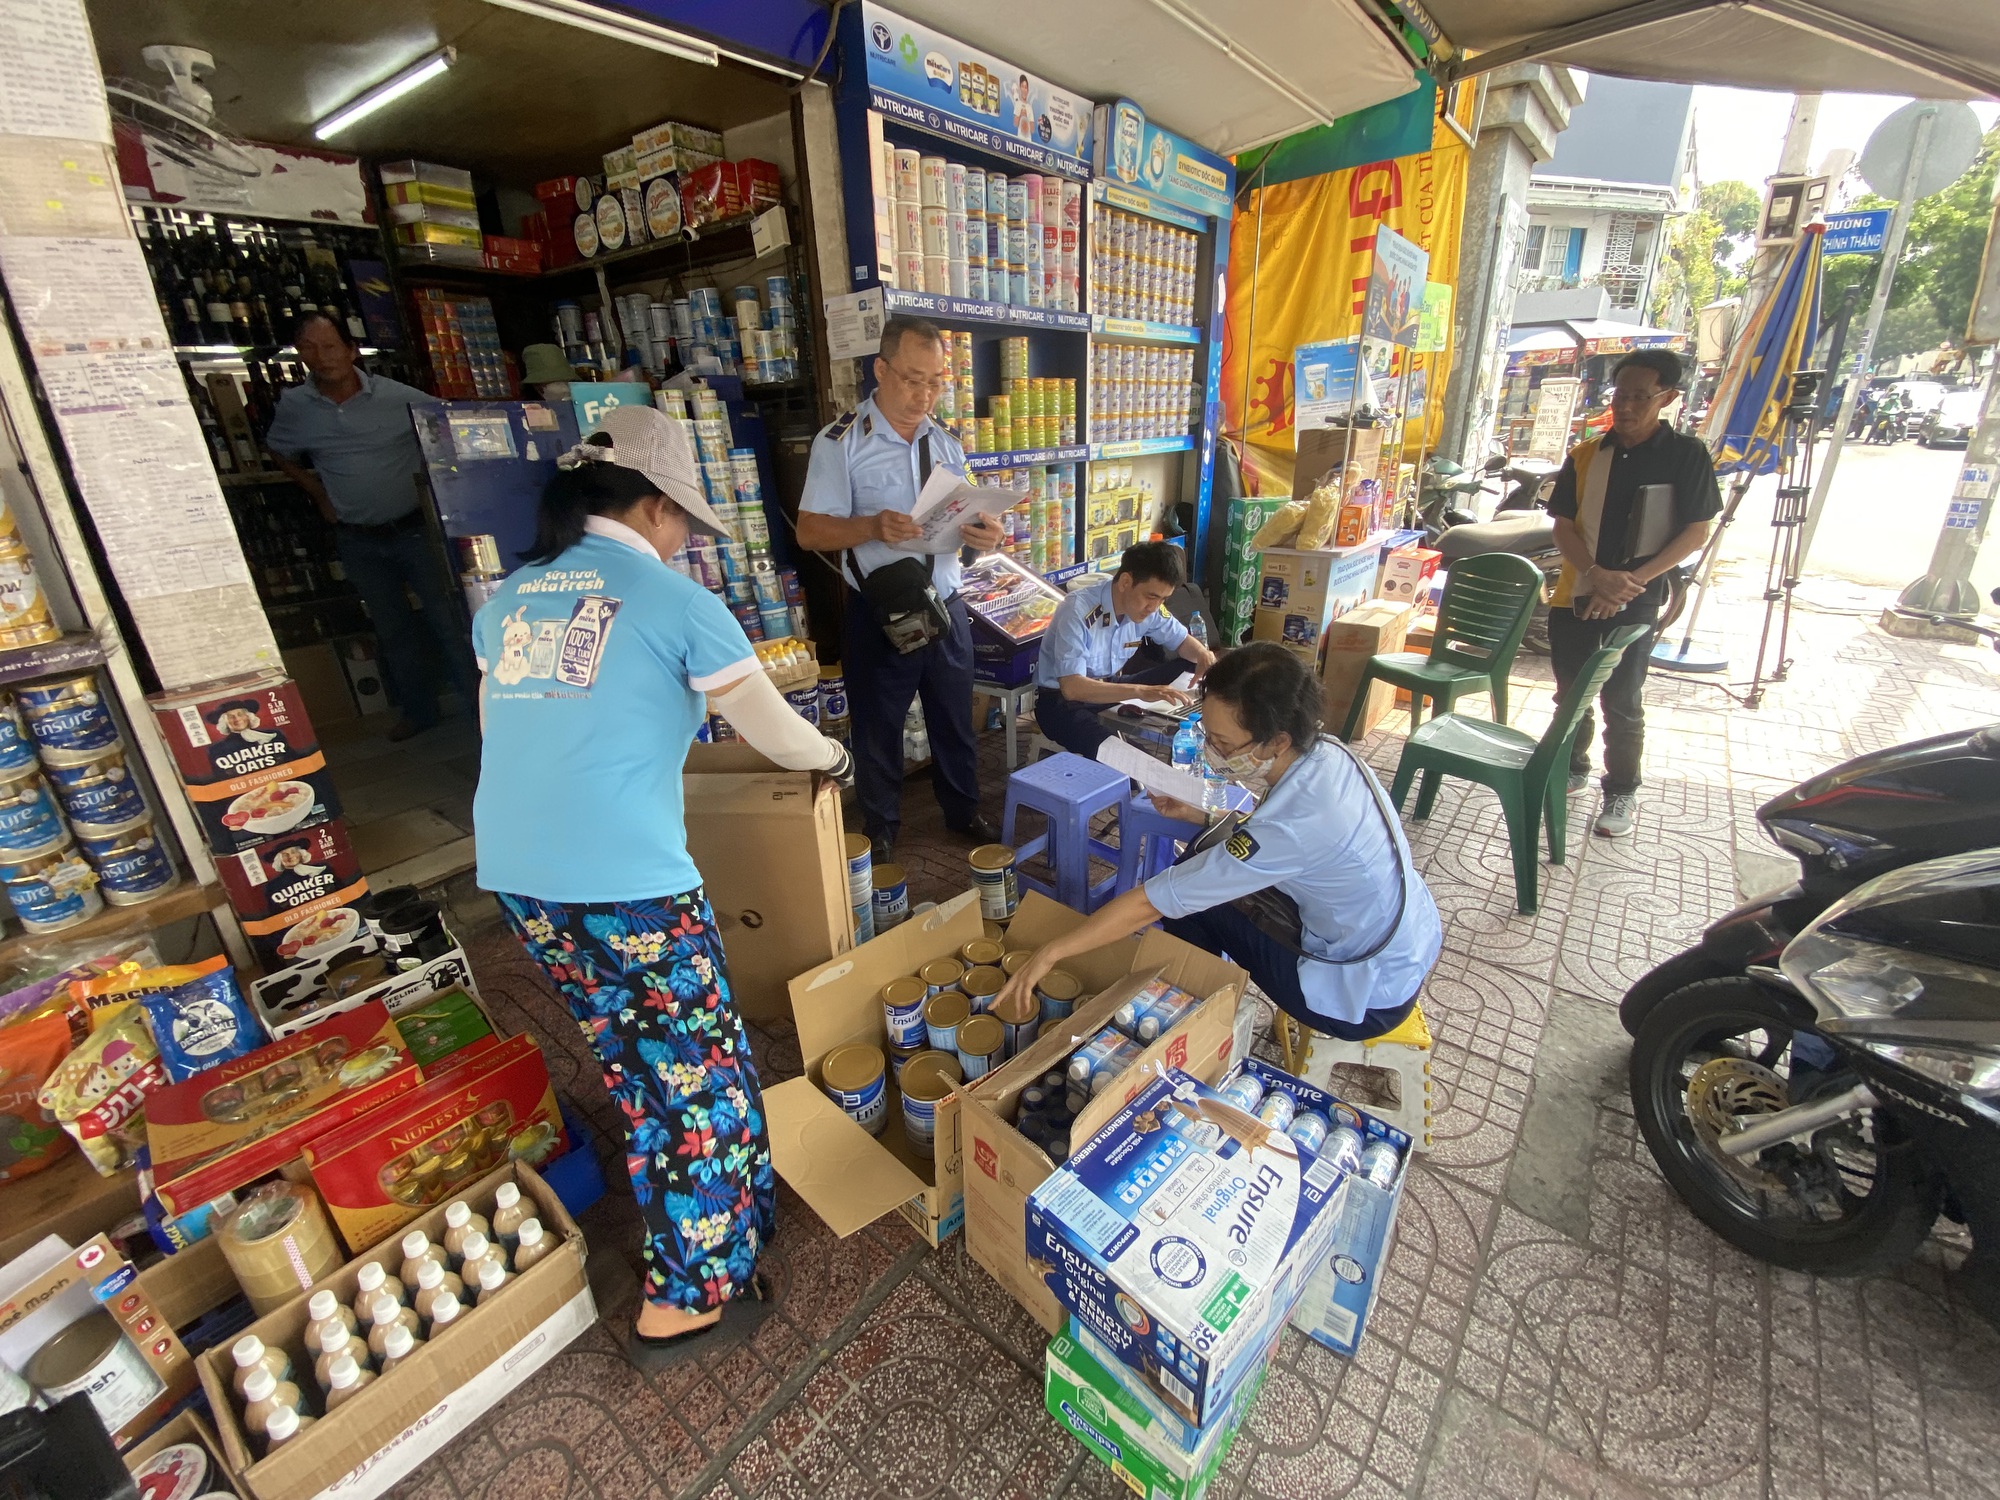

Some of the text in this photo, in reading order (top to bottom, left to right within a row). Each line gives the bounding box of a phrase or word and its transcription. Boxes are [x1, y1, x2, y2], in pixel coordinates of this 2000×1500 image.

[874, 96, 925, 122] NUTRICARE
[945, 120, 988, 145] NUTRICARE
[1006, 141, 1043, 162] NUTRICARE
[1058, 158, 1088, 178] NUTRICARE
[1178, 162, 1201, 176] SYNBIOTIC
[1850, 229, 1881, 248] THẮNG
[887, 294, 934, 310] NUTRICARE
[953, 302, 994, 316] NUTRICARE
[1010, 309, 1044, 322] NUTRICARE
[1058, 314, 1088, 326] NUTRICARE
[1013, 452, 1046, 464] NUTRICARE
[1058, 448, 1086, 458] NUTRICARE
[546, 570, 567, 580] Sữa
[1058, 565, 1086, 581] NUTRICARE
[559, 578, 604, 592] Fresh
[568, 629, 594, 649] 100%
[268, 692, 276, 702] 2
[275, 700, 284, 708] LB
[32, 708, 96, 738] Ensure
[216, 742, 286, 770] QUAKER
[236, 756, 276, 775] OATS
[230, 768, 294, 792] OLD FASHIONED
[320, 828, 326, 838] 2
[272, 873, 335, 904] QUAKER
[290, 886, 326, 906] OATS
[284, 896, 342, 923] OLD FASHIONED
[388, 1001, 402, 1010] NZ
[892, 1010, 923, 1026] Ensure
[180, 1019, 236, 1050] DEVONDALE
[220, 1044, 292, 1080] NUNEST
[1868, 1076, 1970, 1128] HONDA
[388, 1108, 461, 1151] NUNEST
[1070, 1110, 1134, 1167] STRENGTH & ENERGY
[1110, 1143, 1134, 1167] Chocolate
[1173, 1183, 1188, 1198] 220
[1191, 1167, 1230, 1211] nutrition shake
[1202, 1176, 1247, 1224] Original
[1228, 1164, 1284, 1248] Ensure
[1107, 1228, 1134, 1258] SUPPORTS
[1045, 1231, 1106, 1286] Ensure
[1064, 1262, 1106, 1304] Original
[1066, 1278, 1133, 1345] STRENGTH
[1068, 1290, 1076, 1302] &
[1079, 1299, 1130, 1350] ENERGY
[1186, 1320, 1204, 1342] PACK
[1195, 1326, 1218, 1351] 30
